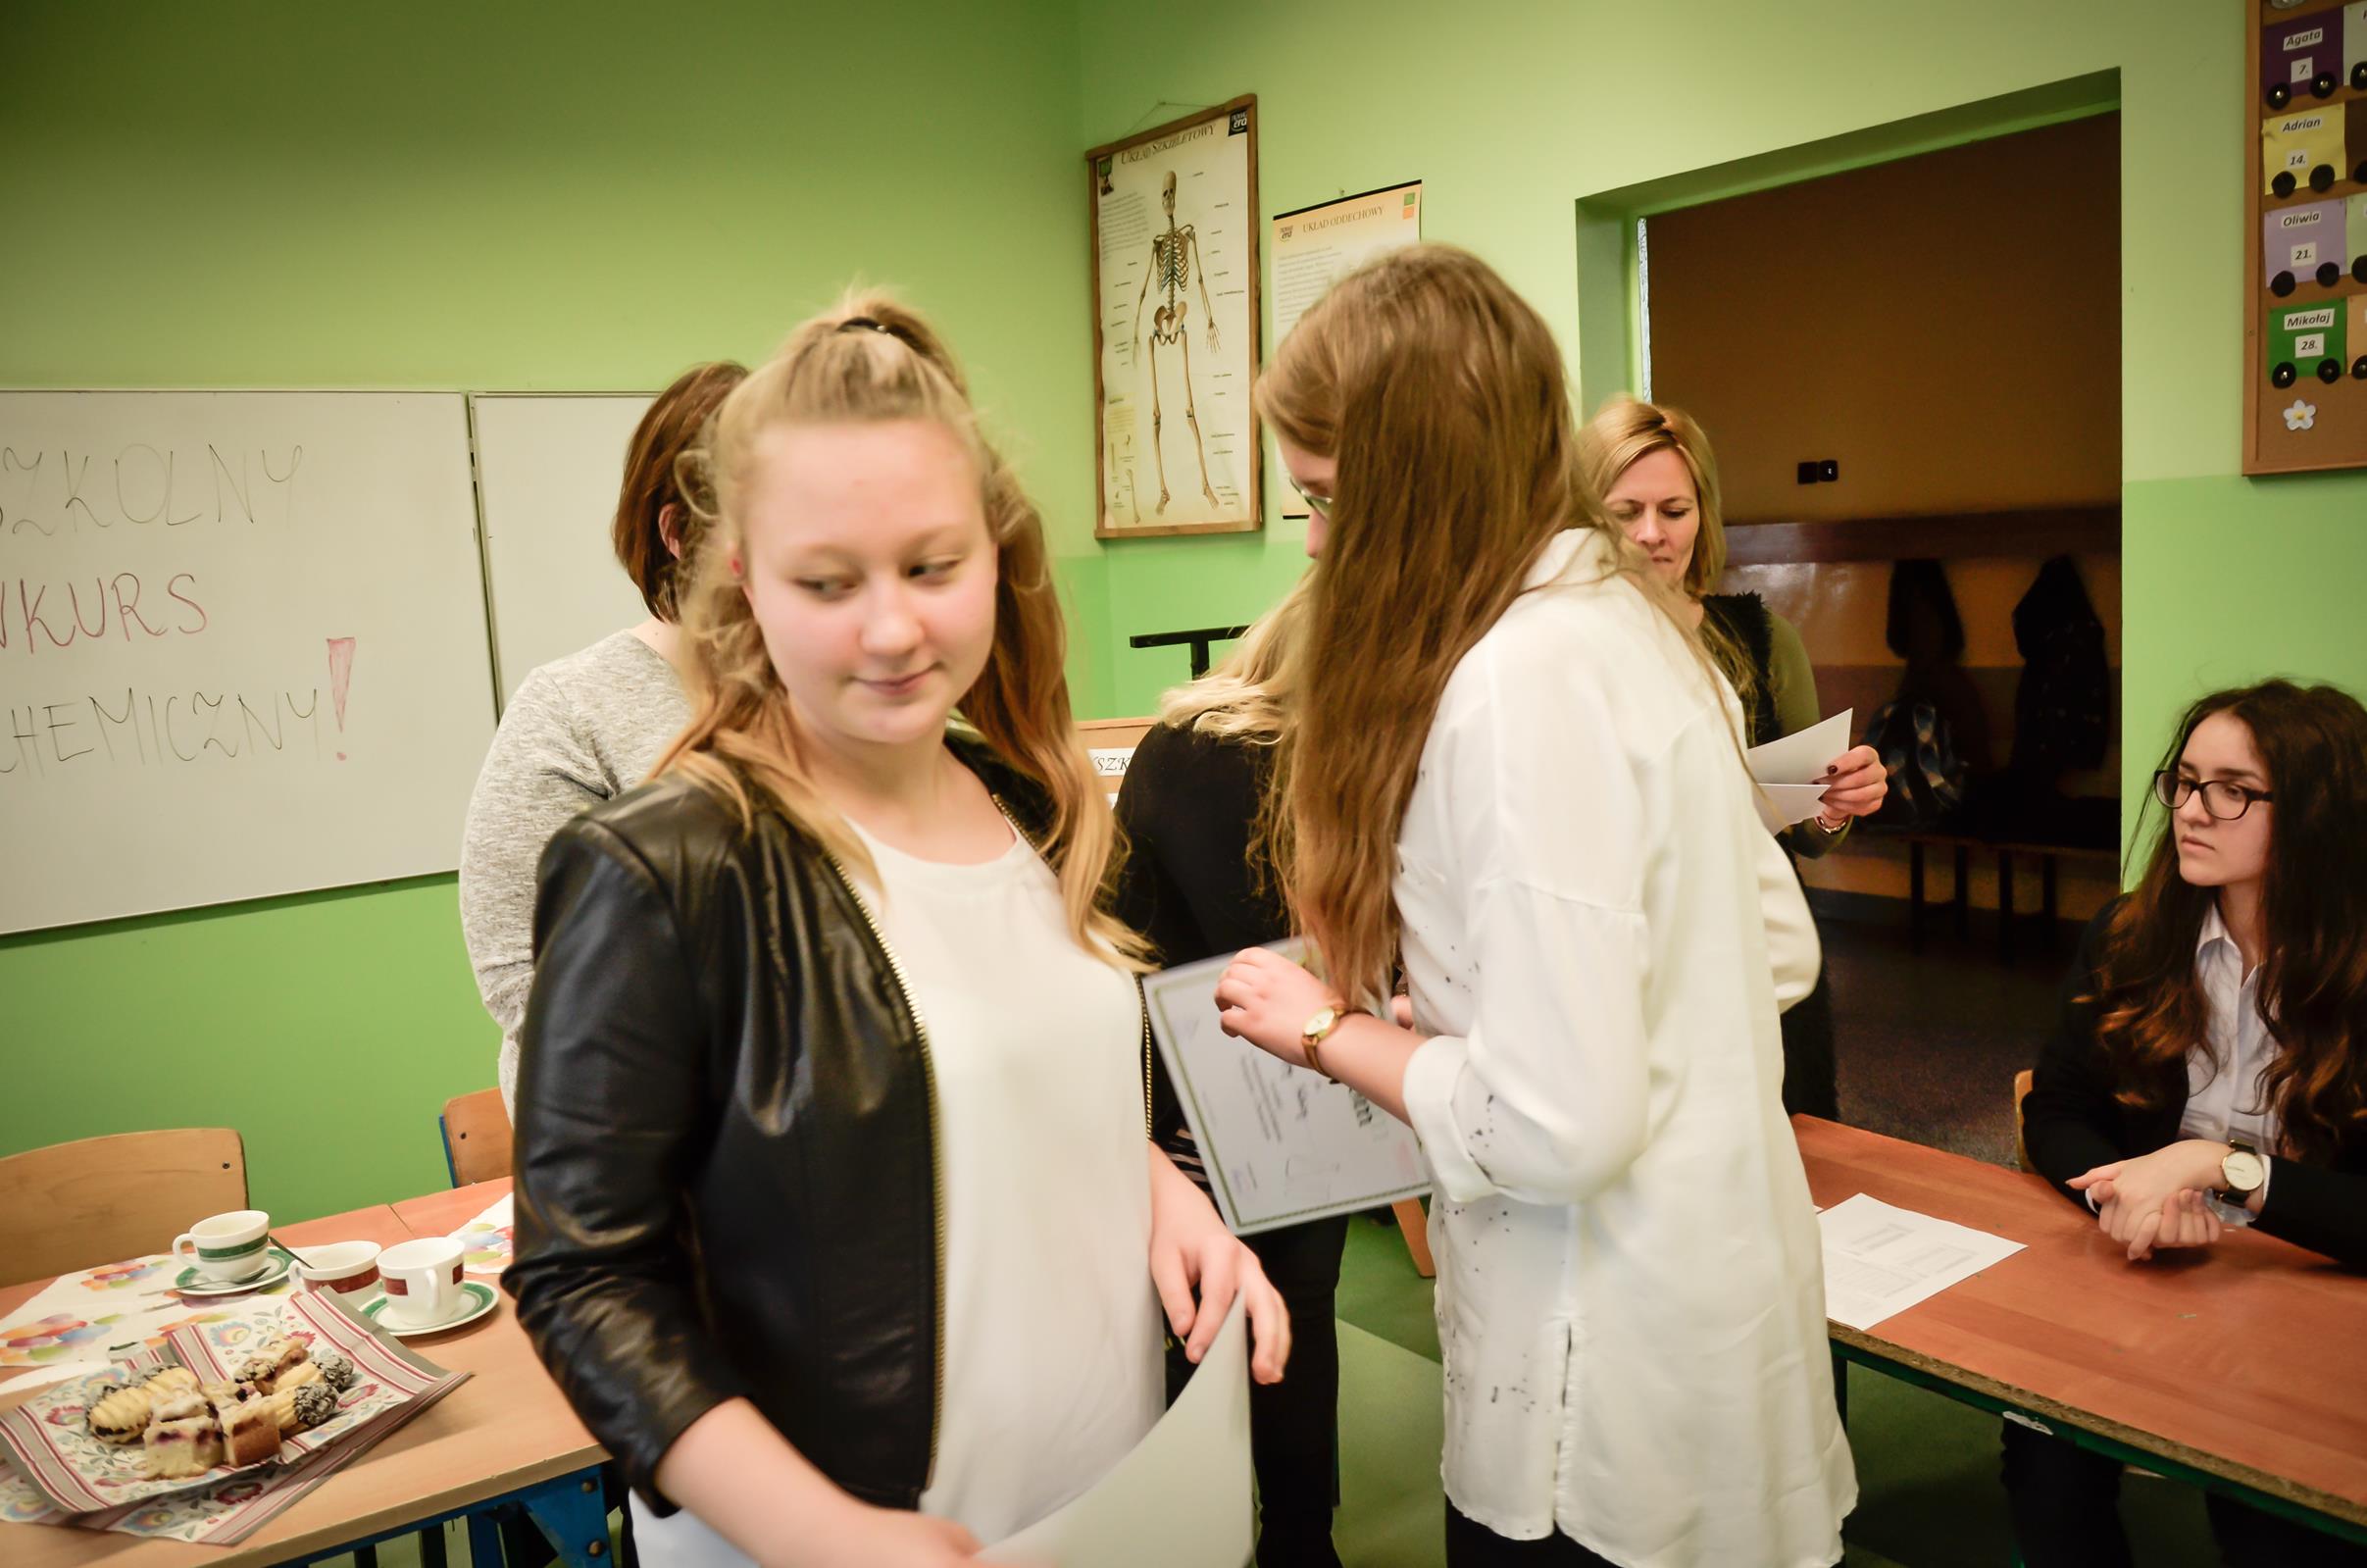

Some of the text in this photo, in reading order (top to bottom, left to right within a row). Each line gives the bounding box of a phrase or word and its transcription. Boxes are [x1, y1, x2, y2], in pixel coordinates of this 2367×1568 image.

[2286, 30, 2321, 46] Agata
[2283, 118, 2321, 131] Adrian
[2290, 155, 2305, 165] 14.
[2284, 212, 2320, 226] Oliwia
[2294, 249, 2312, 260] 21.
[2300, 340, 2318, 350] 28.
[0, 443, 303, 536] ZKOLNY
